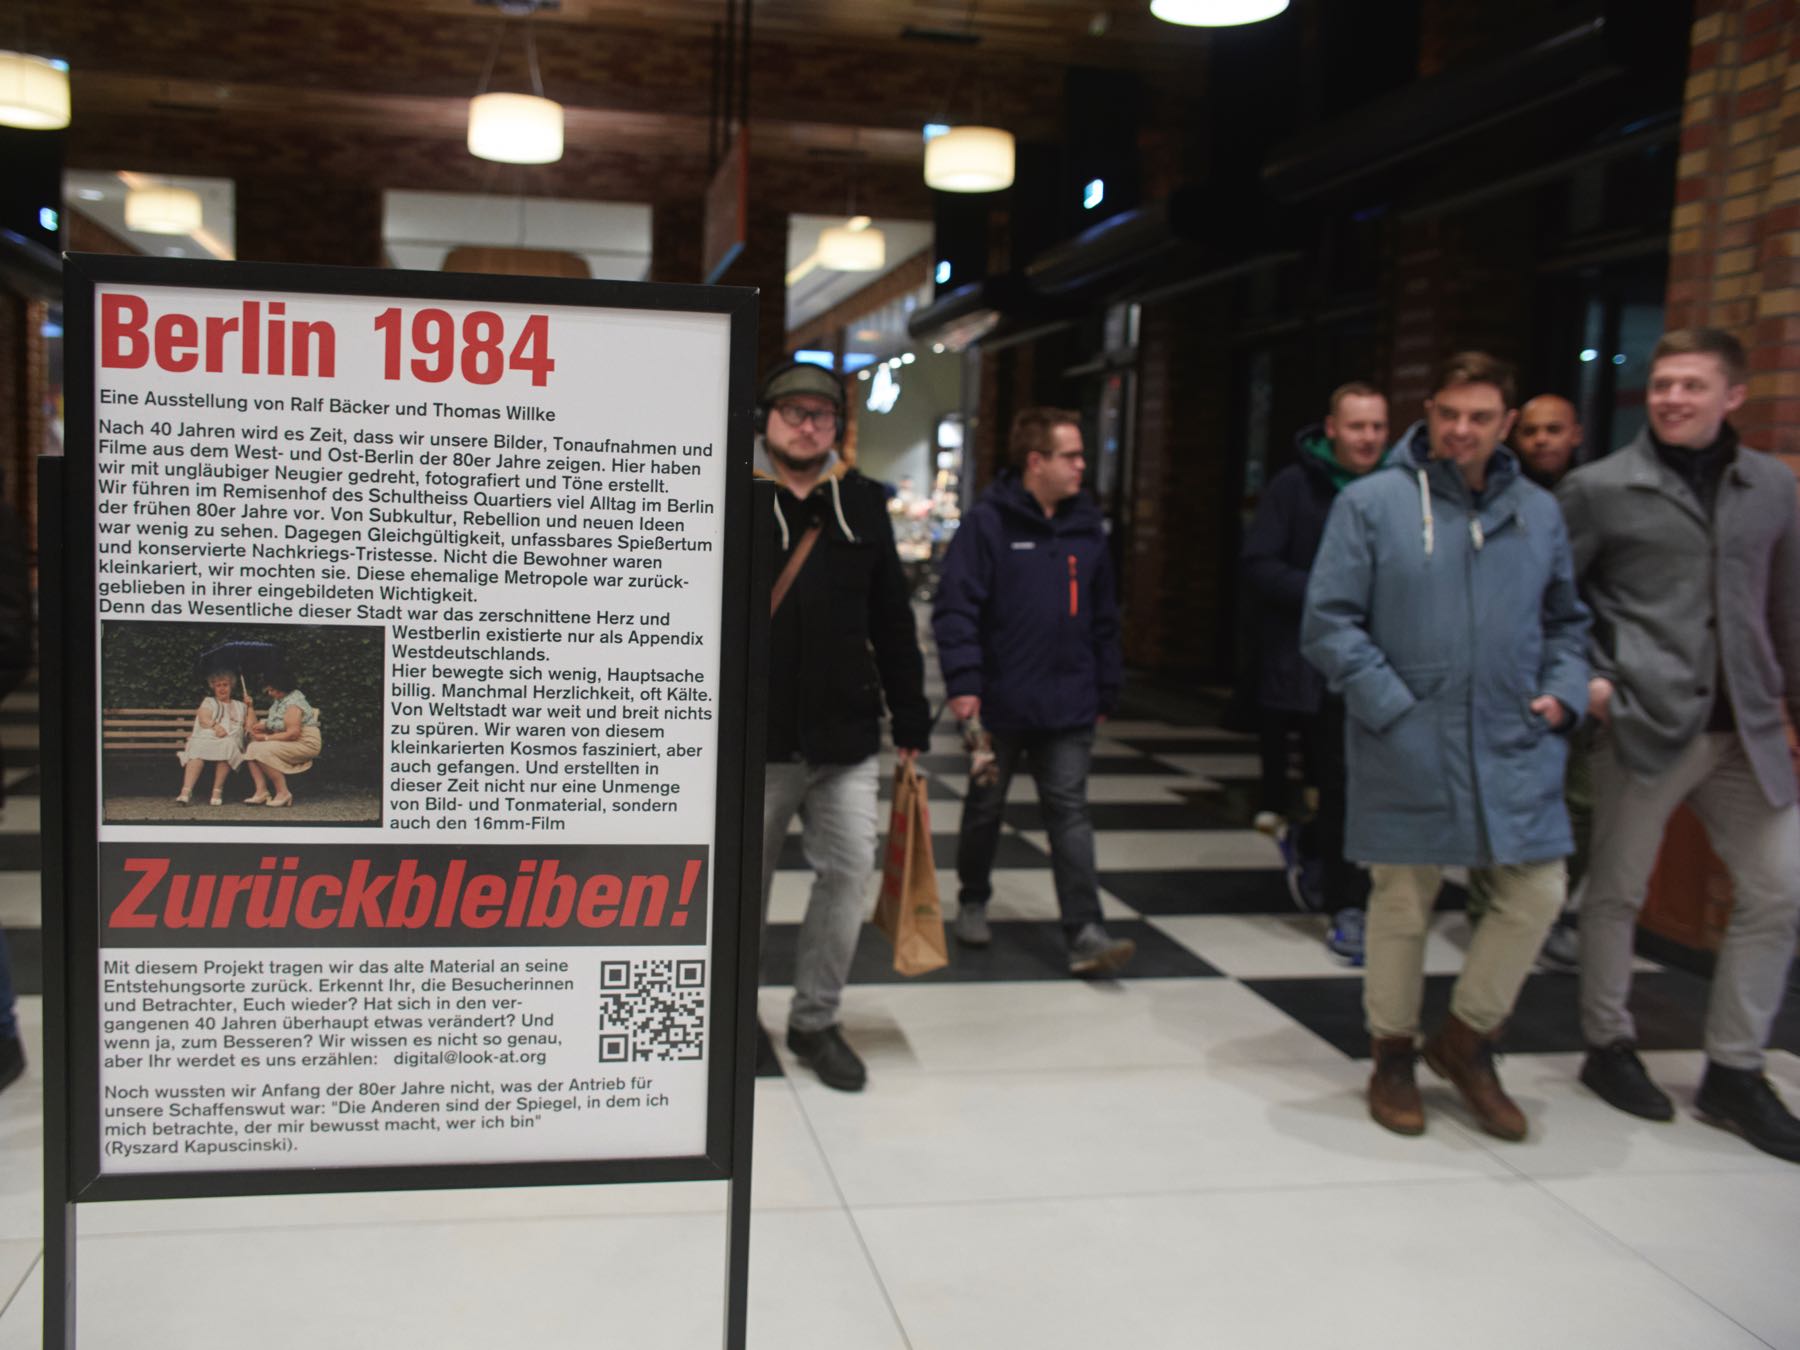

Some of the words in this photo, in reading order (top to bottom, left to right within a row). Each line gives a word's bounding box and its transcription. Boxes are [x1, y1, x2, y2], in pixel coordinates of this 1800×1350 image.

[101, 293, 335, 378] Berlin
[374, 308, 555, 387] 1984
[100, 389, 139, 405] Eine
[144, 390, 248, 413] Ausstellung
[253, 399, 284, 411] von
[290, 396, 324, 412] Ralf
[329, 398, 390, 415] Bäcker
[395, 402, 427, 417] und
[432, 402, 501, 420] Thomas
[506, 405, 556, 422] Willke
[99, 419, 144, 435] Nach
[150, 421, 172, 436] 40
[177, 422, 235, 439] Jahren
[241, 424, 278, 440] wird
[284, 429, 305, 442] es
[309, 426, 347, 445] Zeit,
[353, 428, 394, 445] dass
[399, 431, 425, 446] wir
[430, 435, 489, 449] unsere
[494, 433, 547, 453] Bilder,
[552, 436, 677, 456] Tonaufnahmen
[682, 443, 713, 457] und
[98, 459, 126, 475] wir
[131, 460, 159, 476] mit
[165, 462, 270, 482] ungläubiger
[275, 465, 343, 484] Neugier
[348, 468, 420, 487] gedreht,
[424, 470, 521, 490] fotografiert
[525, 475, 557, 490] und
[561, 475, 603, 491] Töne
[608, 478, 669, 494] erstellt.
[98, 479, 127, 495] Wir
[132, 480, 190, 497] führen
[196, 482, 217, 497] im
[223, 483, 327, 501] Remisenhof
[332, 487, 364, 503] des
[368, 487, 468, 506] Schultheiss
[473, 491, 552, 509] Quartiers
[557, 494, 585, 510] viel
[589, 495, 636, 515] Alltag
[642, 497, 662, 513] im
[667, 498, 714, 514] Berlin
[98, 523, 131, 534] war
[136, 521, 188, 539] wenig
[194, 525, 215, 537] zu
[220, 523, 278, 539] sehen.
[284, 524, 362, 544] Dagegen
[367, 526, 505, 548] Gleichgültigkeit,
[511, 532, 613, 549] unfassbares
[617, 534, 712, 553] Spießertum
[99, 559, 202, 578] kleinkariert,
[208, 562, 235, 577] wir
[240, 563, 316, 579] mochten
[321, 565, 351, 580] sie.
[357, 565, 405, 582] Diese
[410, 567, 499, 587] ehemalige
[504, 569, 588, 589] Metropole
[593, 575, 624, 587] war
[628, 574, 689, 589] zurück-
[99, 579, 185, 596] geblieben
[191, 580, 206, 596] in
[212, 581, 253, 597] ihrer
[257, 583, 374, 601] eingebildeten
[379, 585, 477, 605] Wichtigkeit.
[392, 624, 480, 641] Westberlin
[486, 627, 563, 643] existierte
[567, 632, 595, 644] nur
[599, 629, 623, 644] als
[627, 630, 704, 648] Appendix
[392, 644, 550, 662] Westdeutschlands.
[392, 682, 436, 700] billig.
[442, 683, 527, 699] Manchmal
[533, 684, 634, 703] Herzlichkeit,
[639, 686, 662, 701] oft
[667, 687, 712, 702] Kälte.
[391, 724, 410, 735] zu
[416, 721, 478, 738] spüren.
[484, 722, 511, 737] Wir
[515, 726, 566, 737] waren
[571, 726, 600, 738] von
[605, 723, 665, 738] diesem
[390, 759, 431, 773] auch
[436, 759, 520, 777] gefangen.
[526, 760, 559, 775] Und
[564, 760, 640, 775] erstellten
[645, 761, 659, 775] in
[390, 800, 419, 811] von
[425, 796, 463, 811] Bild-
[468, 797, 500, 812] und
[504, 797, 606, 814] Tonmaterial,
[612, 798, 678, 812] sondern
[390, 815, 431, 830] auch
[436, 815, 467, 830] den
[474, 816, 565, 830] 16mm-Film
[108, 855, 703, 929] Zurückbleiben!
[104, 960, 130, 975] Mit
[134, 960, 198, 975] diesem
[204, 960, 264, 977] Projekt
[269, 960, 323, 977] tragen
[328, 960, 354, 974] wir
[358, 959, 389, 974] das
[393, 959, 425, 974] alte
[430, 959, 495, 974] Material
[499, 962, 520, 973] an
[525, 958, 569, 973] seine
[104, 979, 246, 996] Entstehungsorte
[251, 978, 313, 993] zurück.
[319, 978, 384, 993] Erkennt
[389, 978, 416, 994] Ihr,
[420, 977, 447, 992] die
[451, 976, 574, 992] Besucherinnen
[104, 1019, 189, 1034] gangenen
[194, 1016, 216, 1031] 40
[221, 1016, 277, 1031] Jahren
[282, 1015, 369, 1032] überhaupt
[374, 1015, 423, 1029] etwas
[427, 1013, 516, 1029] verändert?
[521, 1013, 554, 1028] Und
[104, 1054, 143, 1068] aber
[149, 1053, 172, 1068] Ihr
[176, 1053, 236, 1068] werdet
[240, 1056, 261, 1067] es
[266, 1056, 297, 1067] uns
[301, 1052, 378, 1067] erzählen:
[393, 1050, 547, 1068] digital@look-at.org
[105, 1106, 164, 1118] unsere
[169, 1102, 286, 1117] Schaffenswut
[290, 1104, 325, 1115] war:
[331, 1100, 366, 1114] "Die
[371, 1099, 440, 1113] Anderen
[445, 1098, 480, 1112] sind
[484, 1097, 512, 1112] der
[516, 1095, 581, 1113] Spiegel,
[587, 1095, 601, 1109] in
[605, 1094, 641, 1108] dem
[646, 1093, 669, 1107] ich
[105, 1121, 147, 1136] mich
[152, 1121, 238, 1136] betrachte,
[244, 1120, 273, 1134] der
[277, 1119, 305, 1133] mir
[310, 1118, 379, 1133] bewusst
[384, 1117, 440, 1132] macht,
[446, 1119, 476, 1130] wer
[481, 1115, 505, 1129] ich
[510, 1114, 541, 1128] bin"
[105, 1140, 179, 1158] (Ryszard
[184, 1137, 298, 1155] Kapuscinski).
